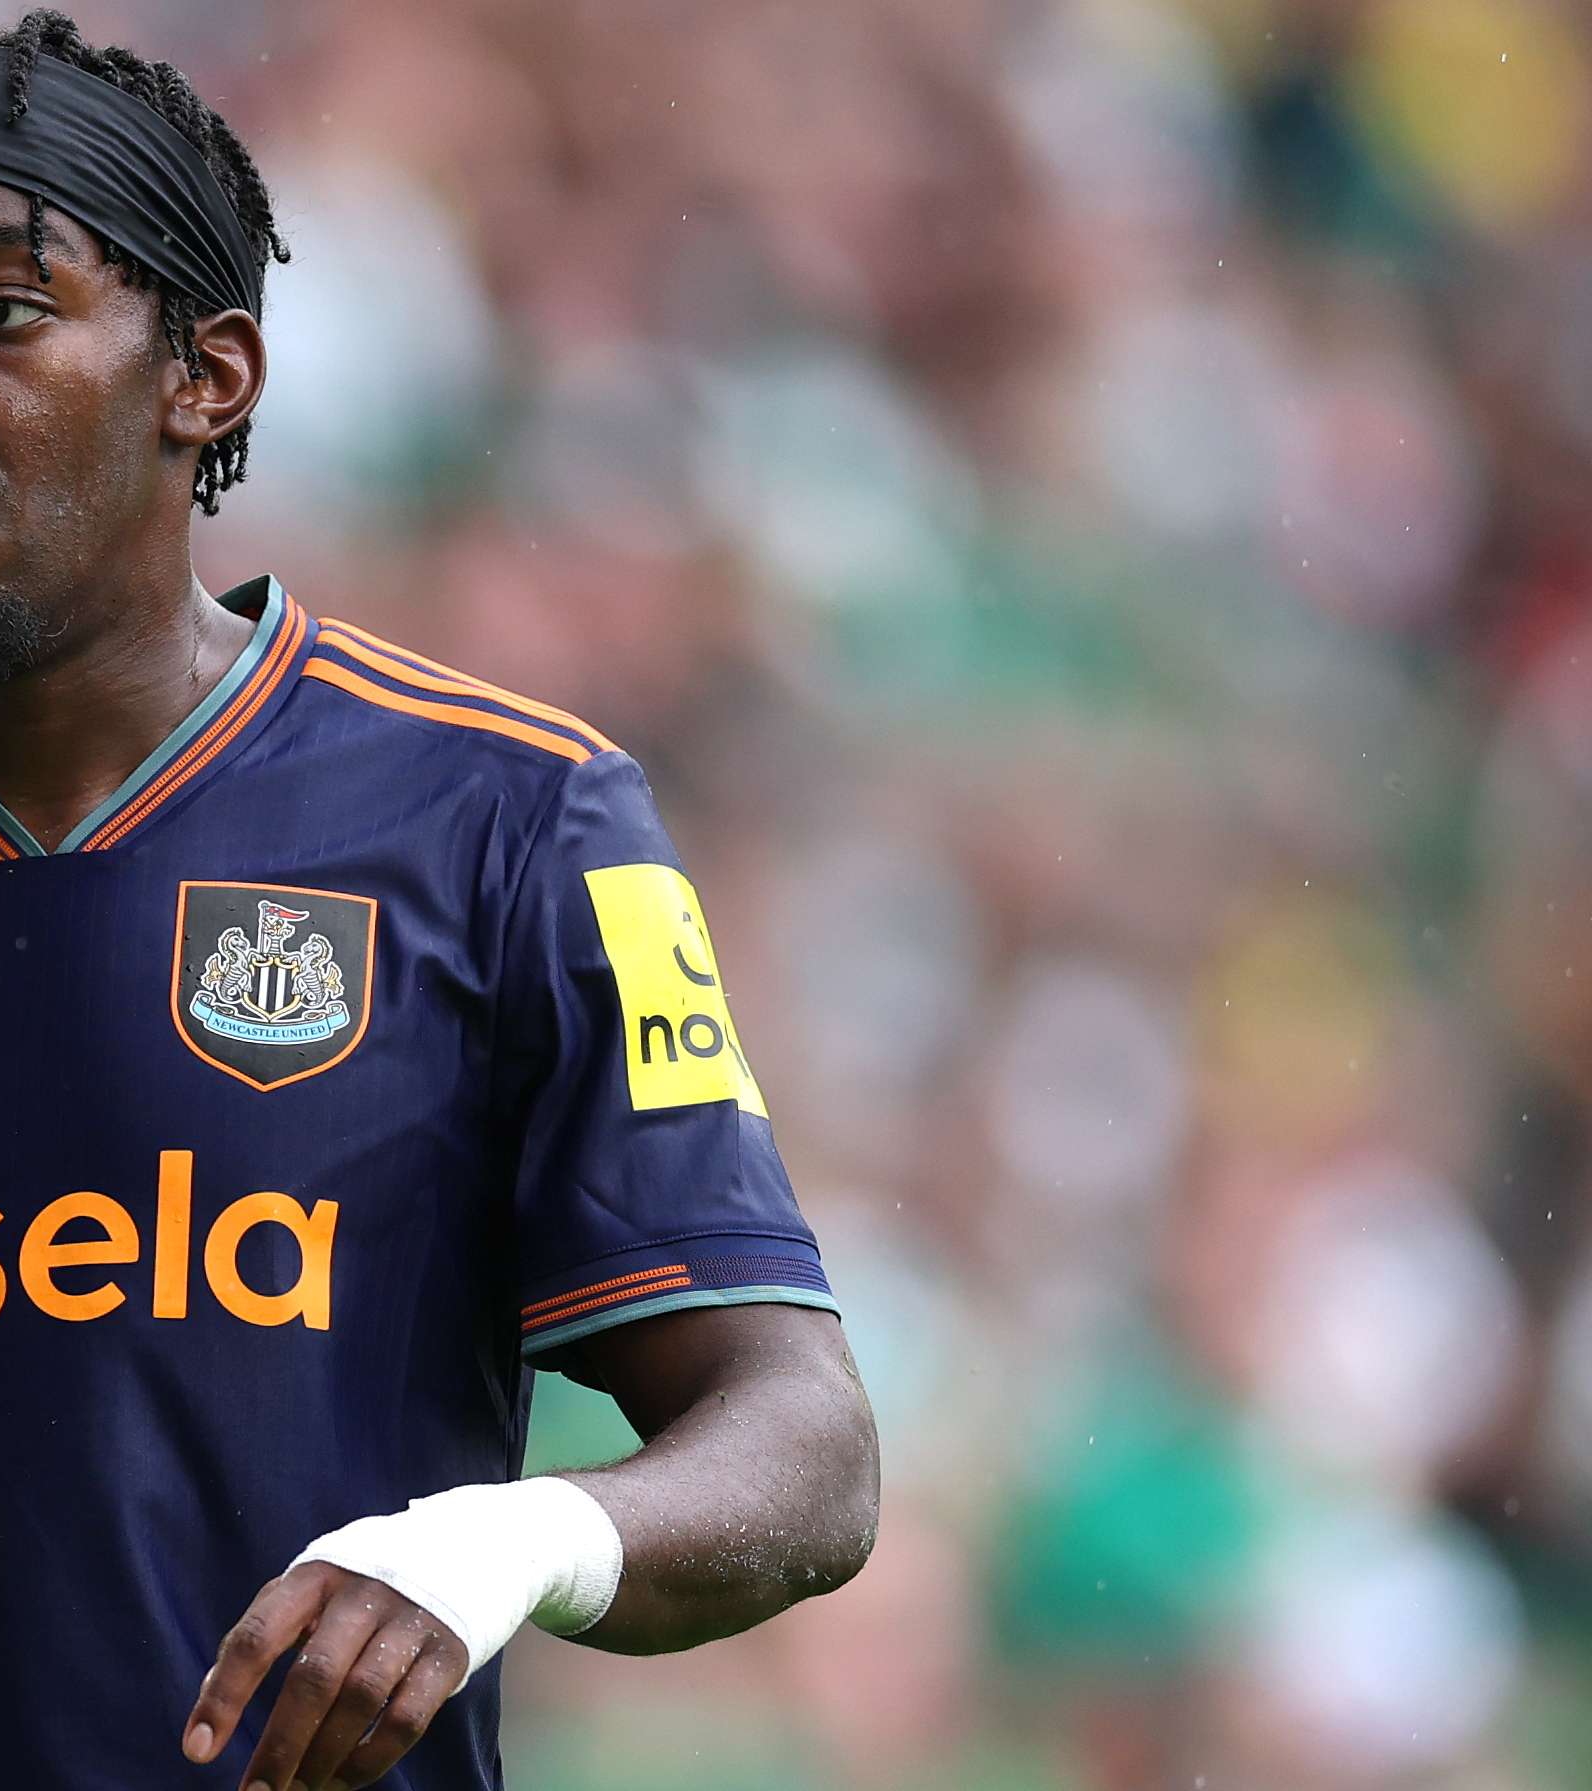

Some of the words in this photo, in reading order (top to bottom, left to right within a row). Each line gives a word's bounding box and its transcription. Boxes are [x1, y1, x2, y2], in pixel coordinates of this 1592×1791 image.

[212, 1017, 280, 1038] NEWCASTLE
[281, 1024, 326, 1039] UNITED
[639, 1012, 749, 1078] no
